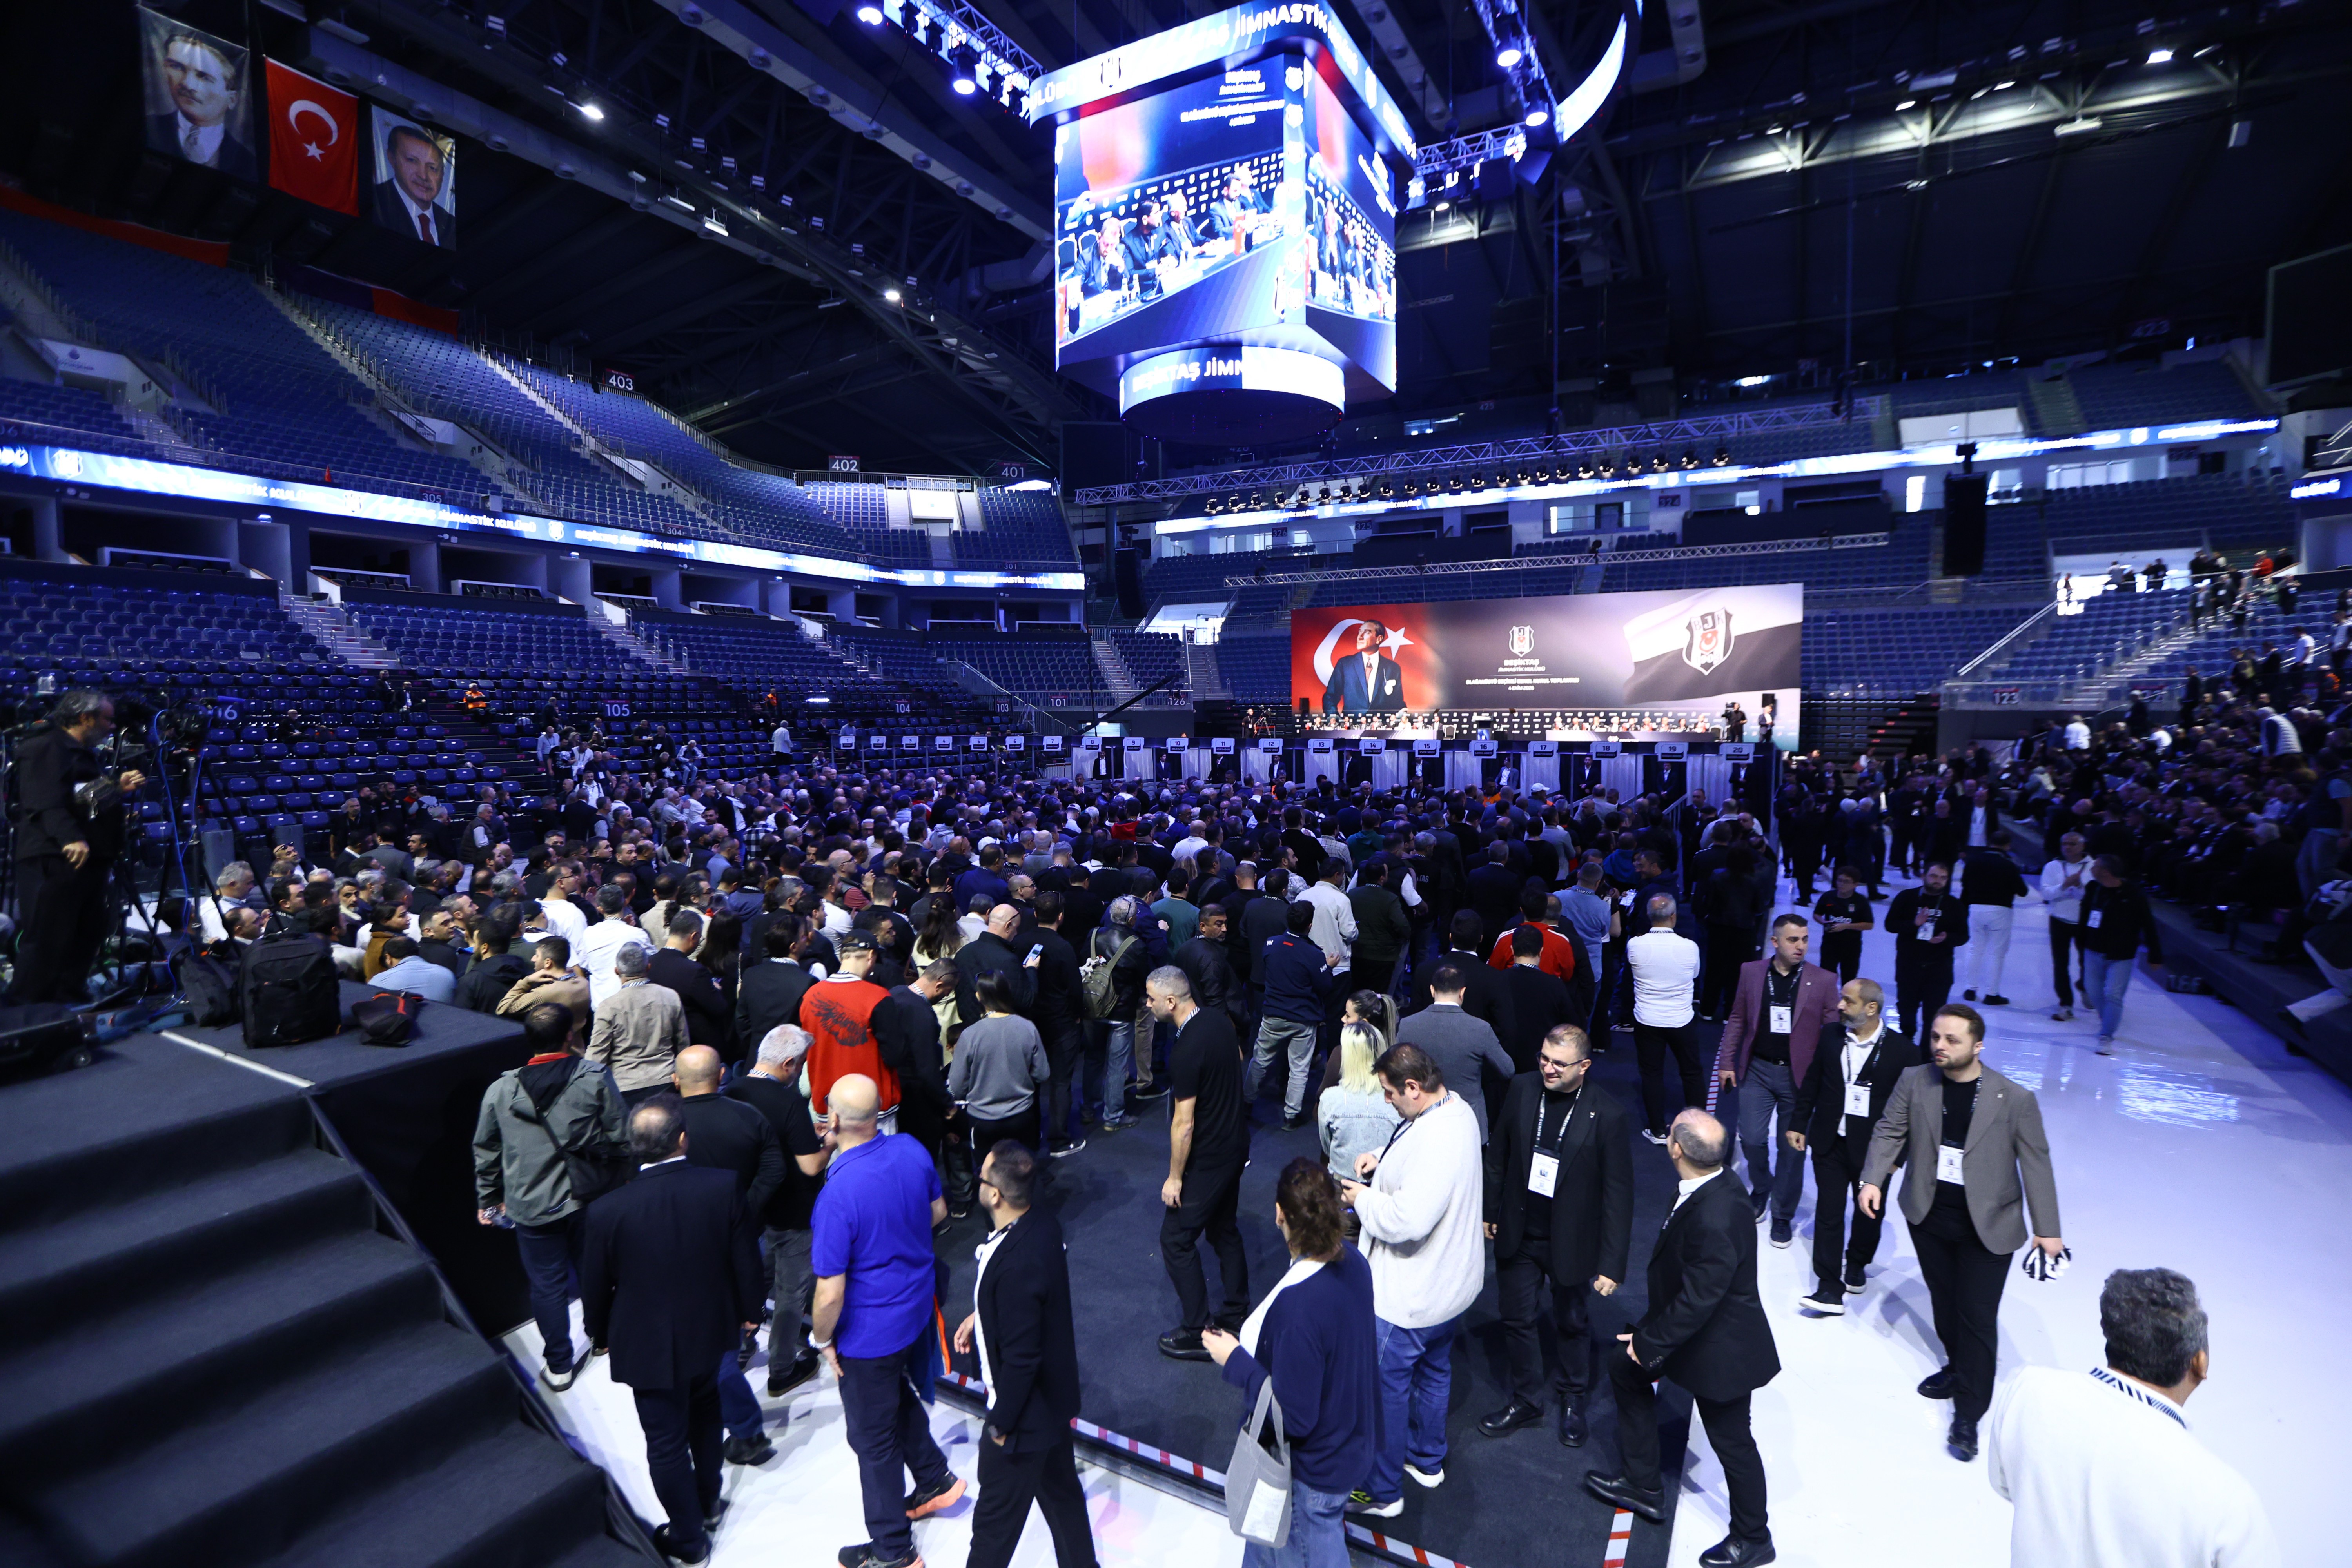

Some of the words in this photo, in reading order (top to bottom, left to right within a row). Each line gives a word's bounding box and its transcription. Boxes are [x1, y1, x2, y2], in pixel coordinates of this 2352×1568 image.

[609, 374, 633, 390] 403
[832, 459, 858, 472] 402
[1002, 466, 1024, 478] 401
[422, 493, 442, 503] 305
[667, 527, 682, 535] 304
[1356, 522, 1372, 530] 325
[1693, 613, 1724, 631] BJK
[1504, 658, 1540, 667] BEŞİKTAŞ
[1993, 692, 2020, 704] 123
[605, 704, 630, 717] 105
[895, 704, 911, 713] 104
[997, 704, 1009, 712] 103
[1320, 964, 1328, 973] HH
